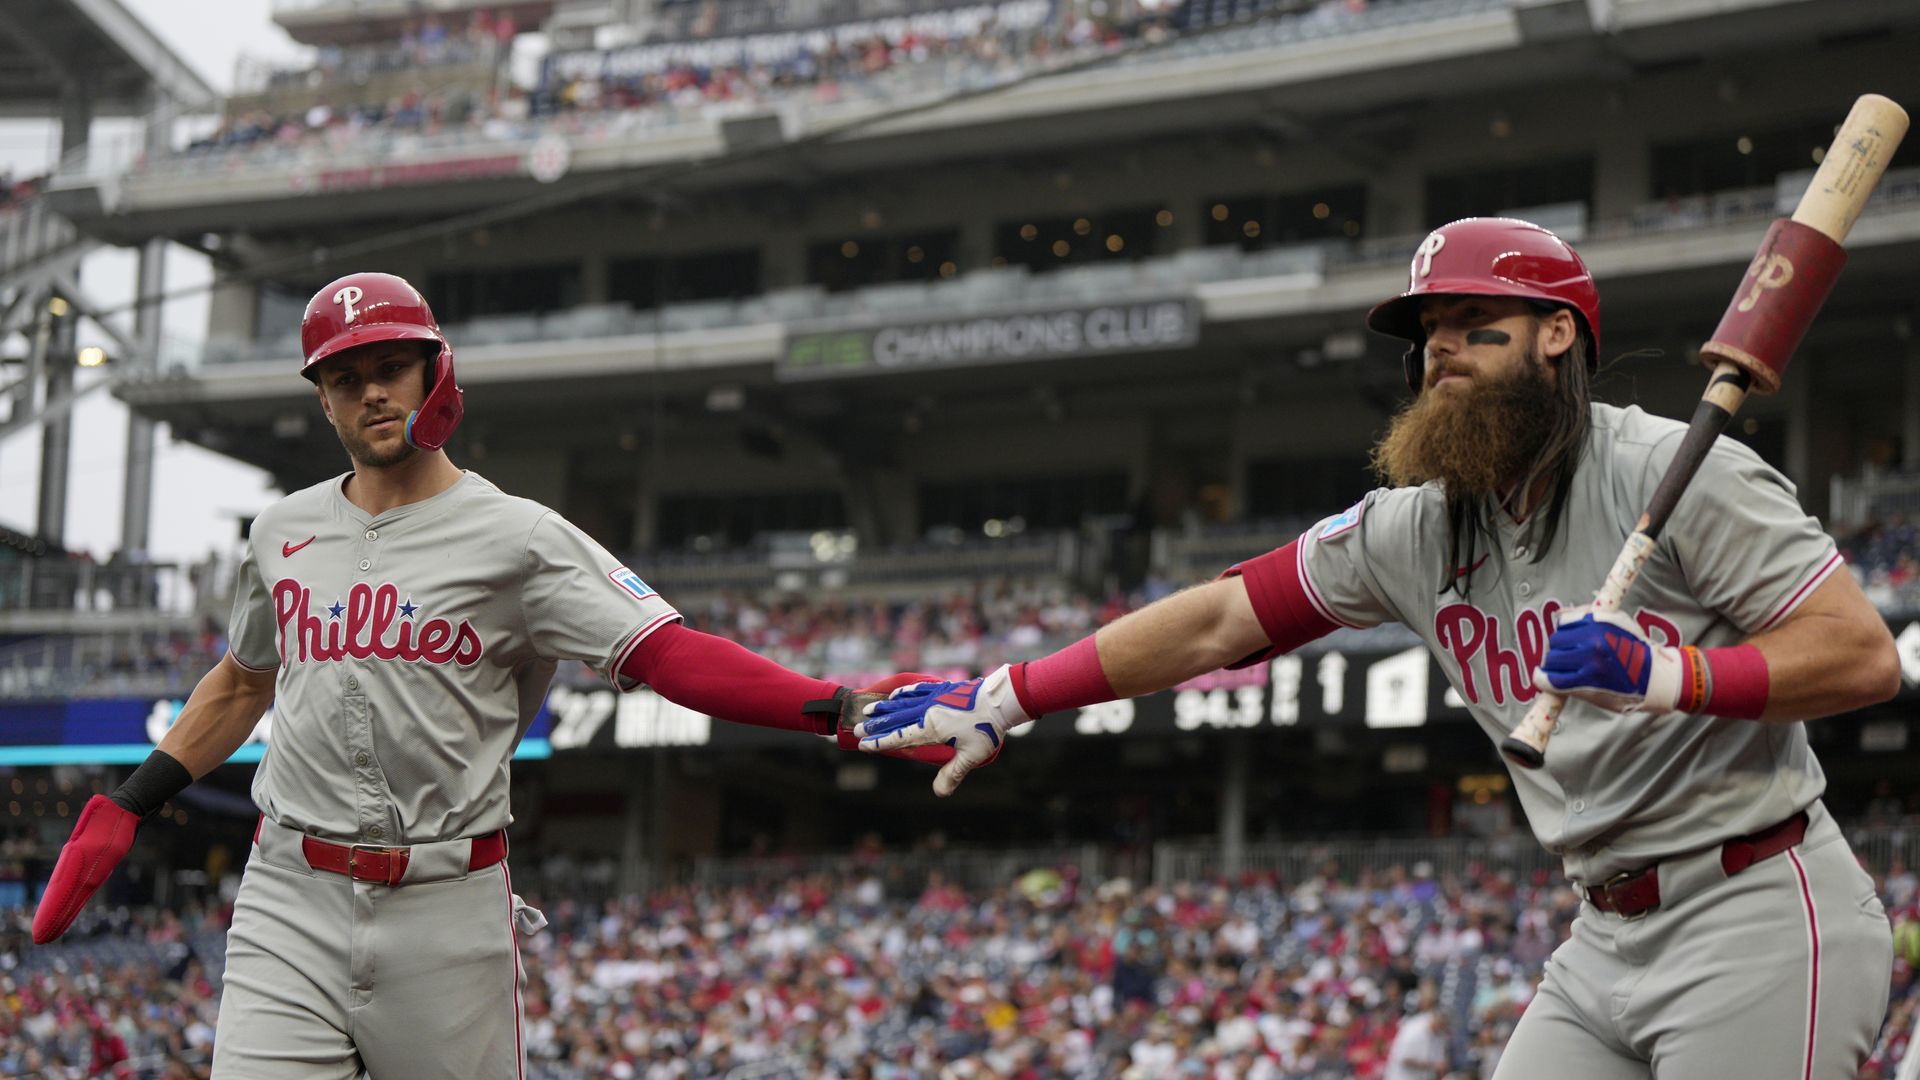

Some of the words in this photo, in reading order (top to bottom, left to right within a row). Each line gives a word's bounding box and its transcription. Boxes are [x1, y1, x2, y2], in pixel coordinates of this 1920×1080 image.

[1418, 233, 1446, 278] P
[1737, 254, 1794, 312] P
[333, 286, 363, 324] P
[873, 308, 1083, 368] CHAMPIONS
[1084, 301, 1185, 348] CLUB
[272, 578, 484, 669] Phillies
